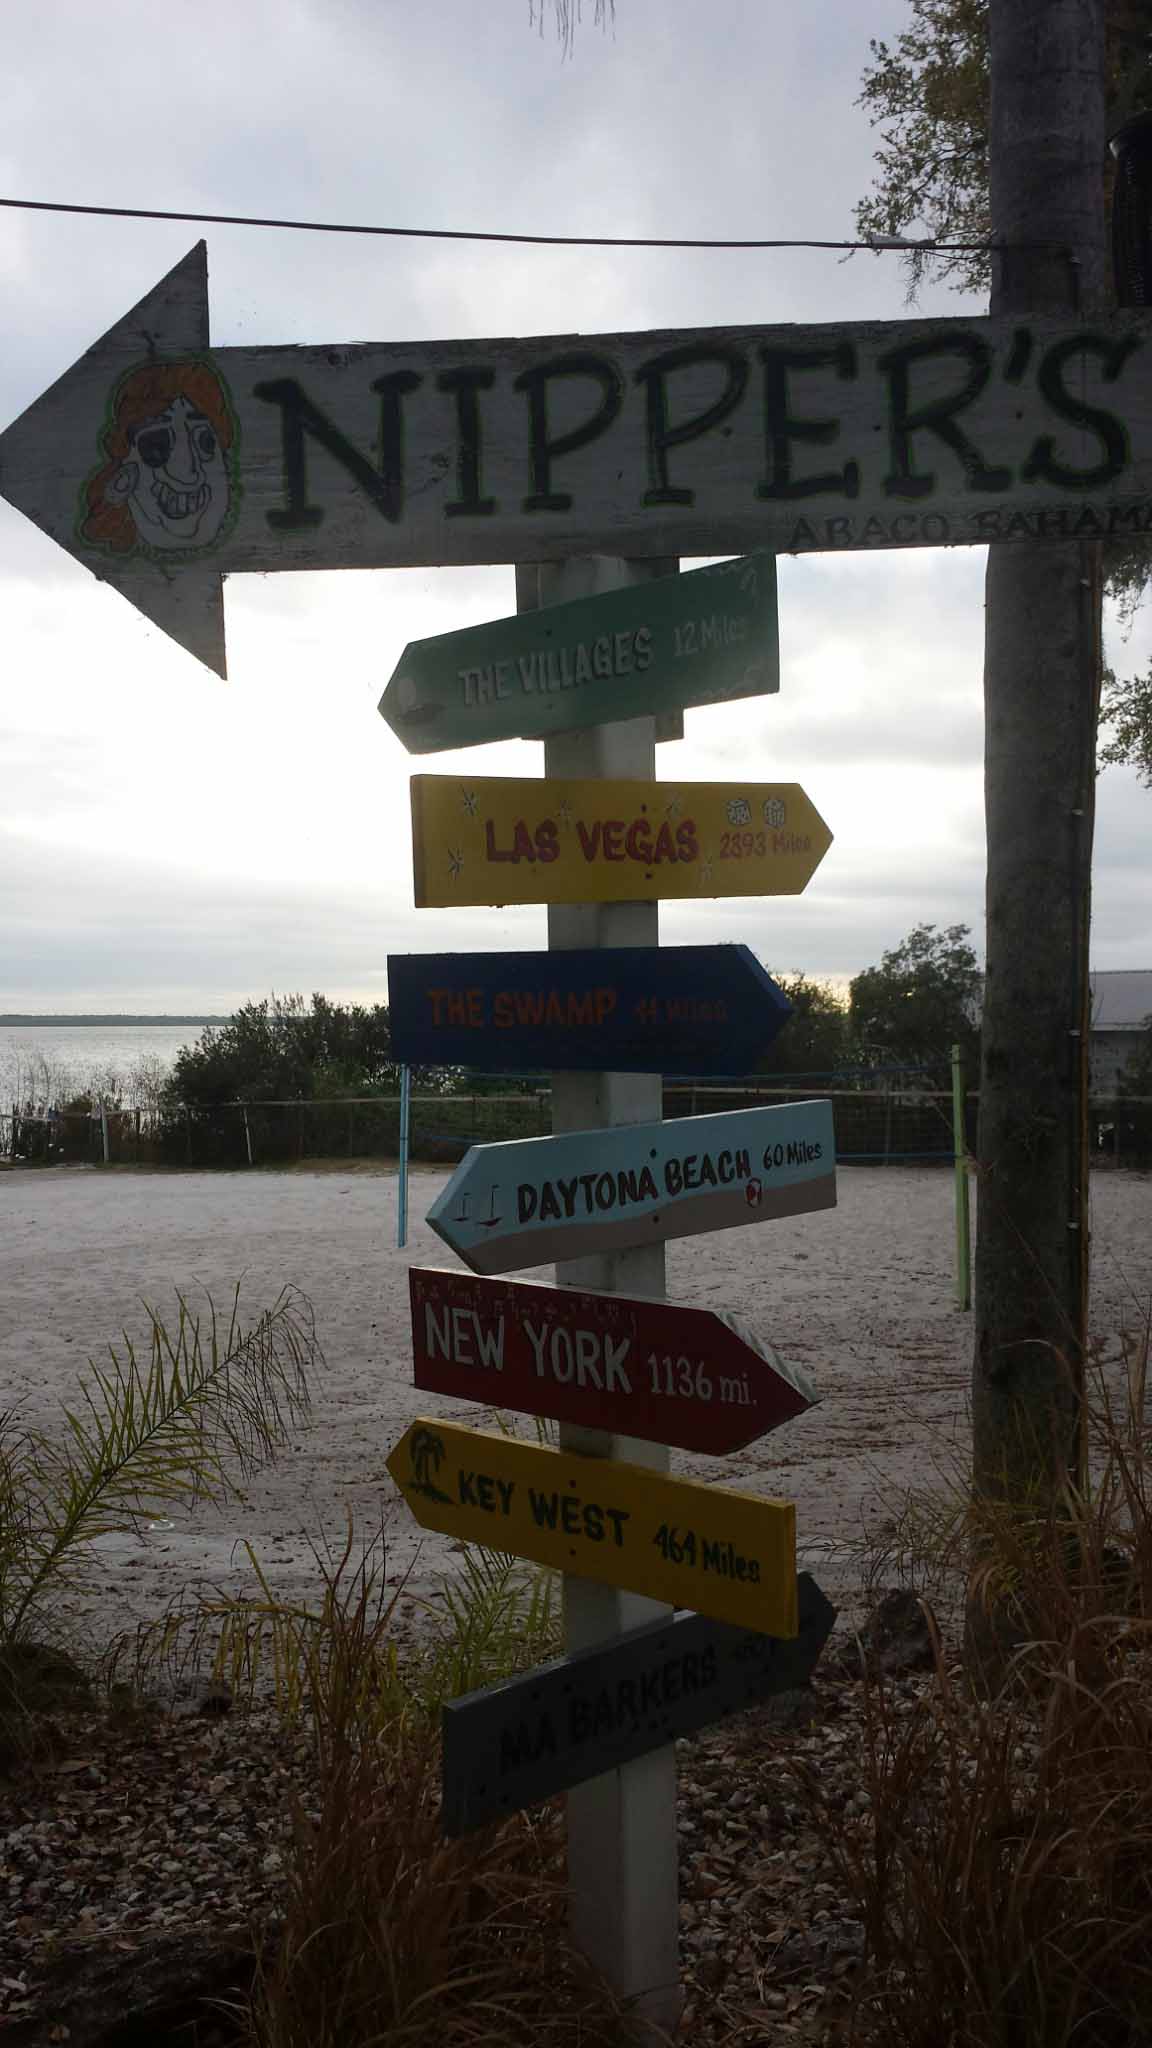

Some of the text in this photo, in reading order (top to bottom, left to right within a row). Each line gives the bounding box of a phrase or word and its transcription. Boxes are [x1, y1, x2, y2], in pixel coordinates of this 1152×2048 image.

[255, 328, 1138, 529] NIPPER'S
[788, 513, 950, 547] ABACO
[457, 667, 511, 705] THE
[517, 625, 654, 695] VILLAGES
[673, 621, 697, 658] 12
[485, 820, 560, 864] LAS
[575, 818, 698, 865] VEGAS
[426, 988, 485, 1028] THE
[494, 987, 617, 1029] SWAMP
[517, 1140, 823, 1224] DAYTONA BEACH 60 Miles
[423, 1301, 505, 1373] NEW
[522, 1318, 632, 1394] YORK
[647, 1352, 713, 1401] 1136
[458, 1469, 516, 1515] KEY
[529, 1487, 632, 1547] WEST
[702, 1538, 761, 1584] Miles
[570, 1645, 718, 1745] BARKERS
